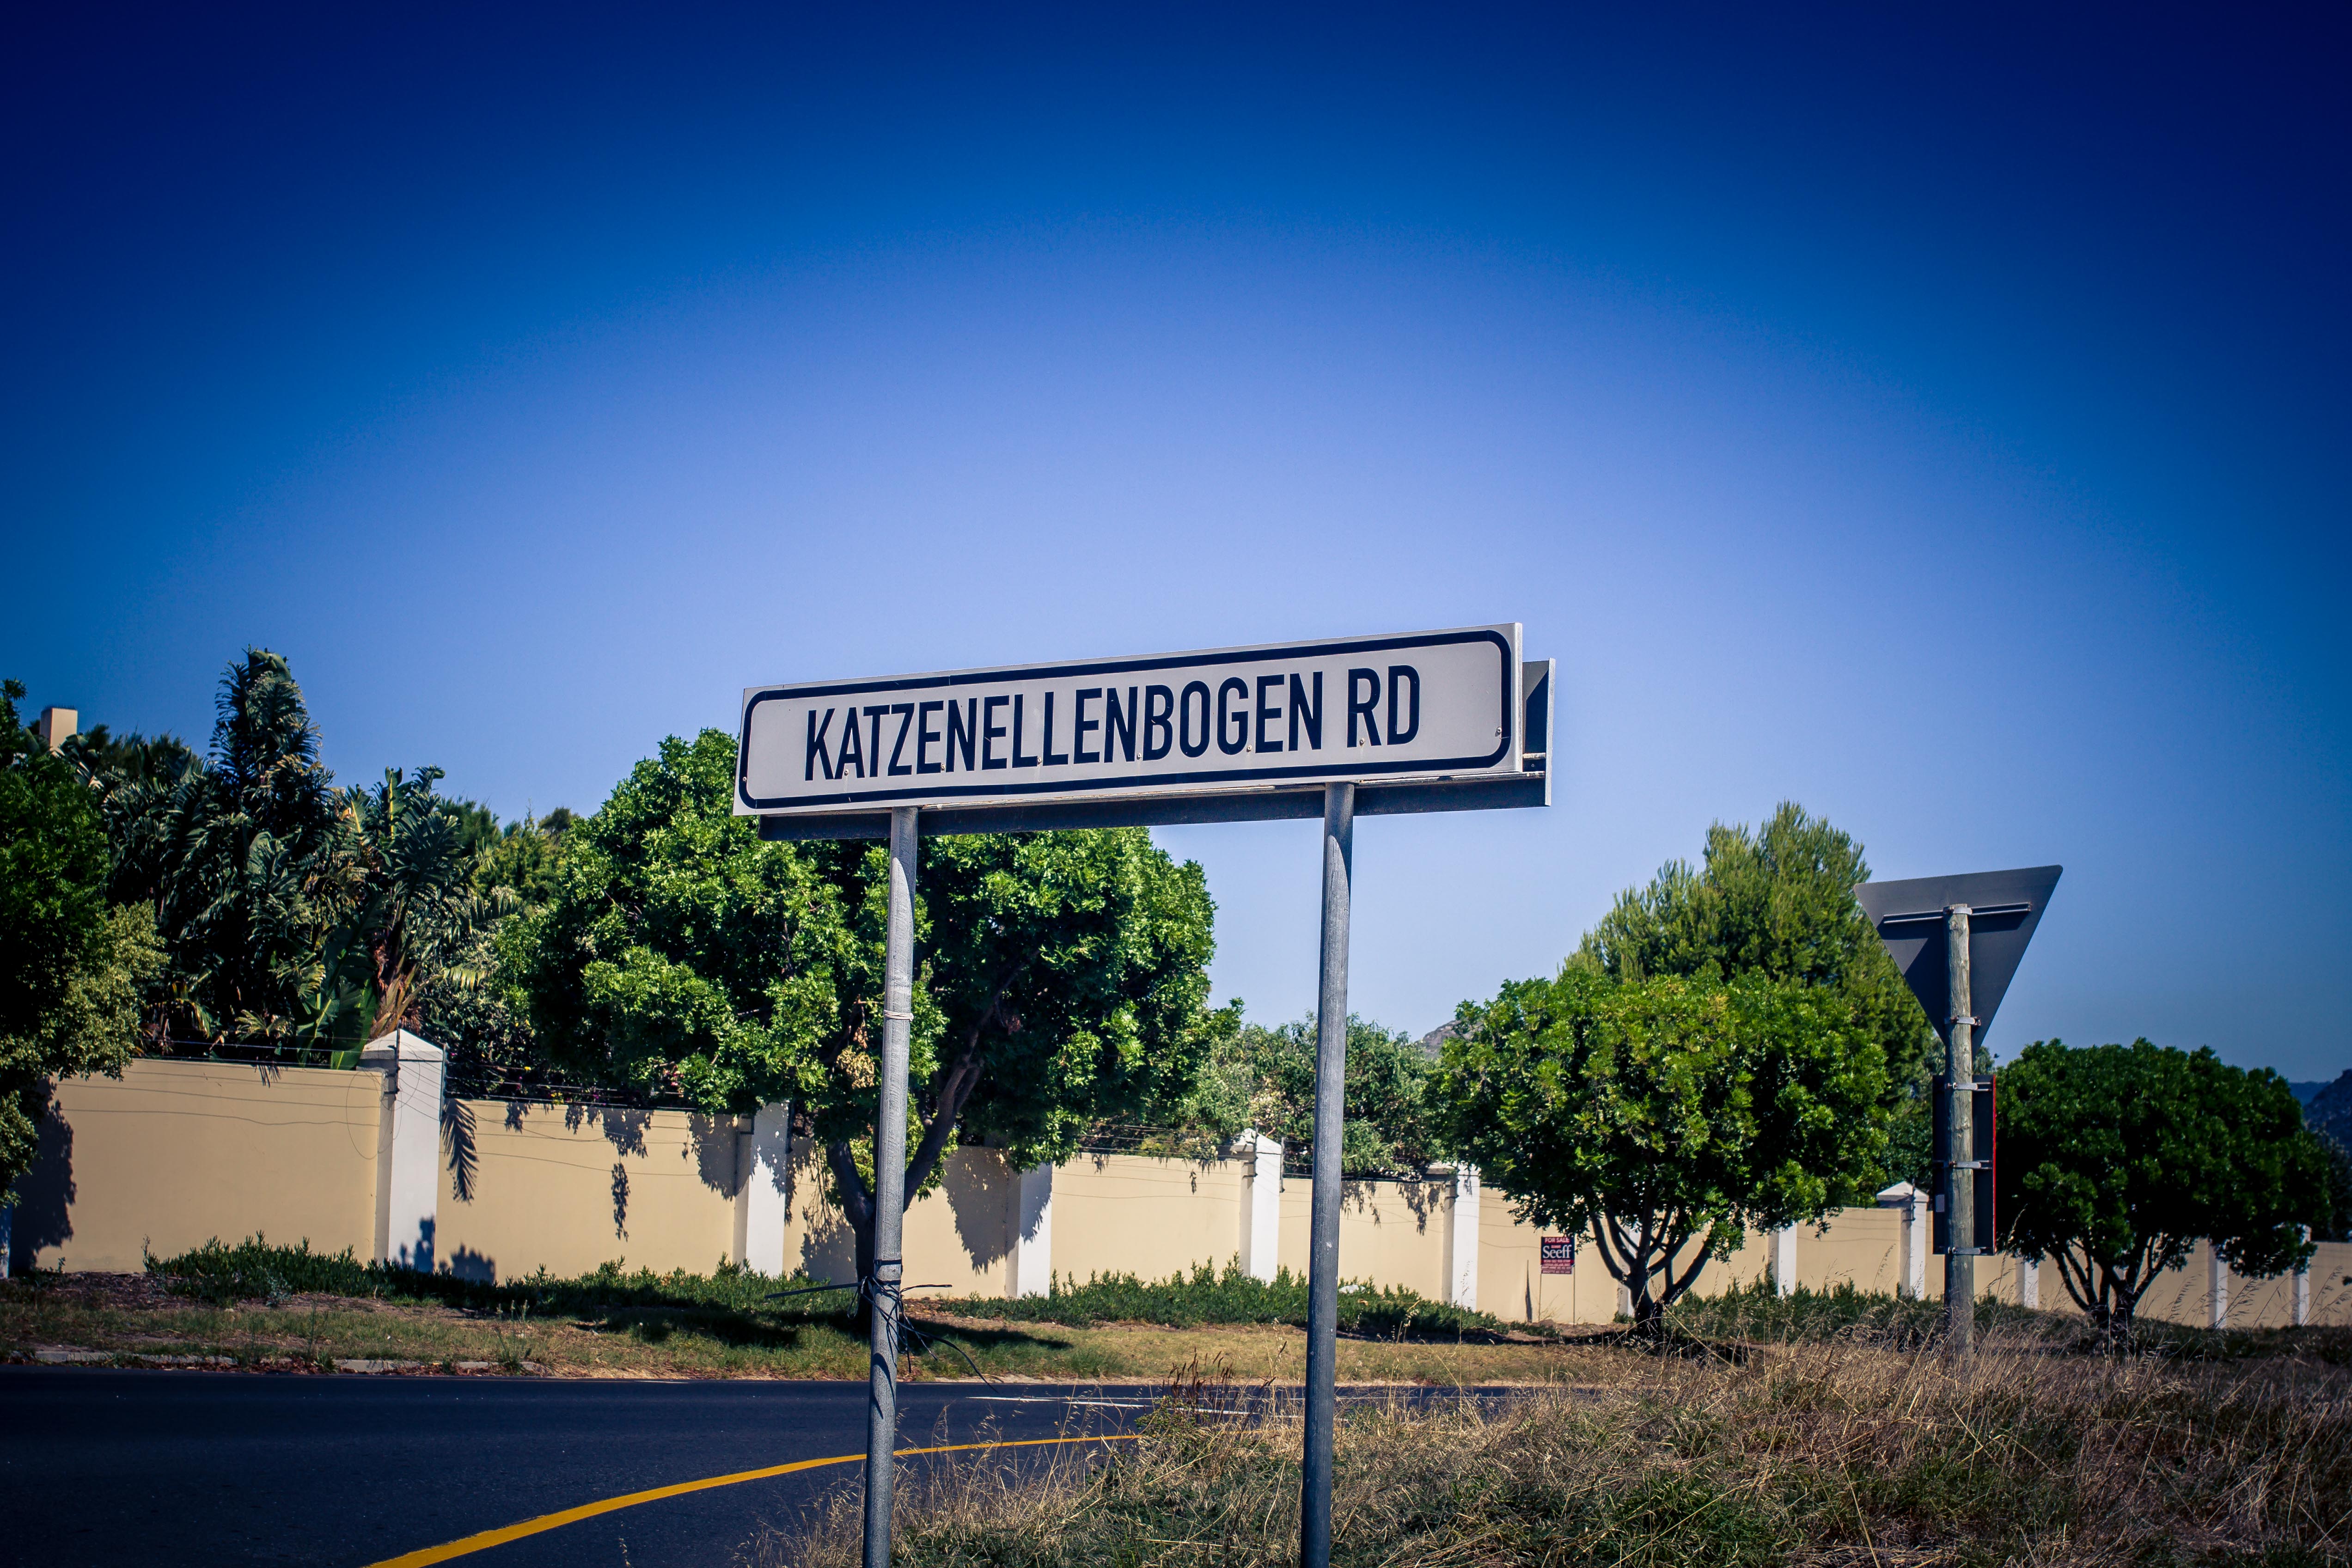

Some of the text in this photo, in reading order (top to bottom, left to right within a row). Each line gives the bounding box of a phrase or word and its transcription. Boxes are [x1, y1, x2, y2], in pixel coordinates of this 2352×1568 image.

[804, 665, 1421, 781] KATZENELLENBOGEN RD
[1542, 1245, 1572, 1258] Seeff
